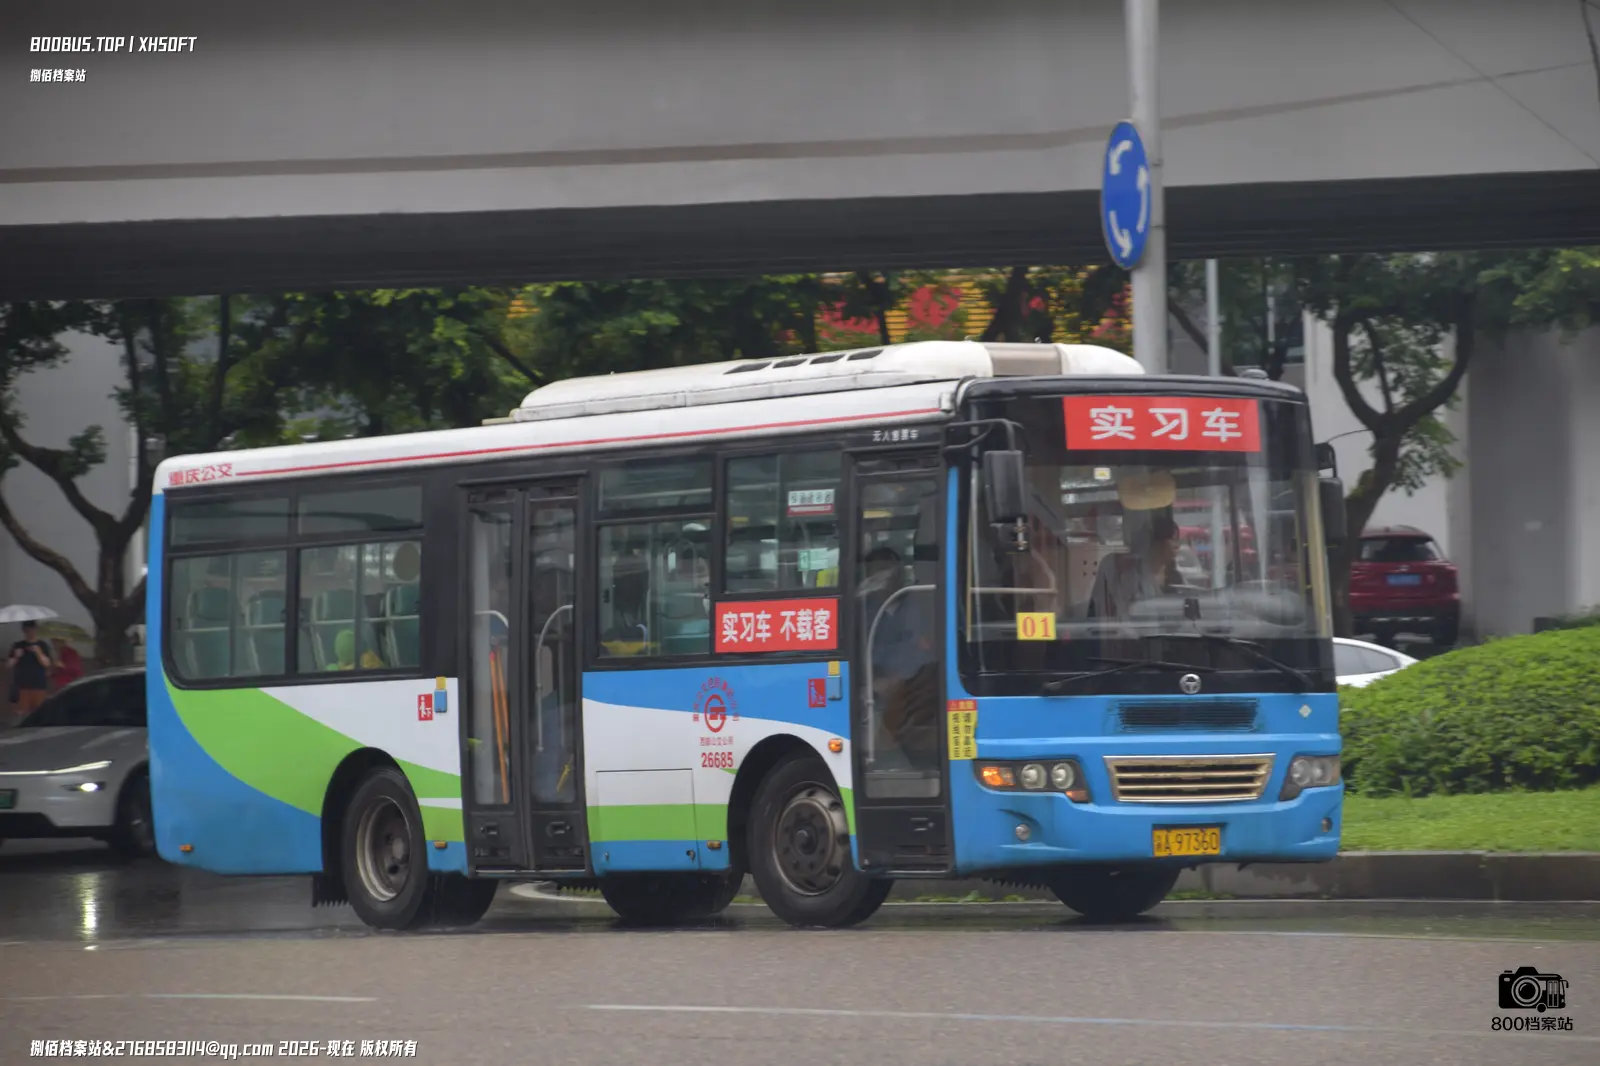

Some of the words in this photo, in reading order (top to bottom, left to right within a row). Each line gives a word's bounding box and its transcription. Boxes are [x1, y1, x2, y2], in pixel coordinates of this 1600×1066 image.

[1089, 405, 1242, 442] 实习车
[722, 610, 772, 643] 实习车
[780, 608, 830, 641] 不载客
[1022, 616, 1052, 637] 01
[701, 751, 734, 768] 26685
